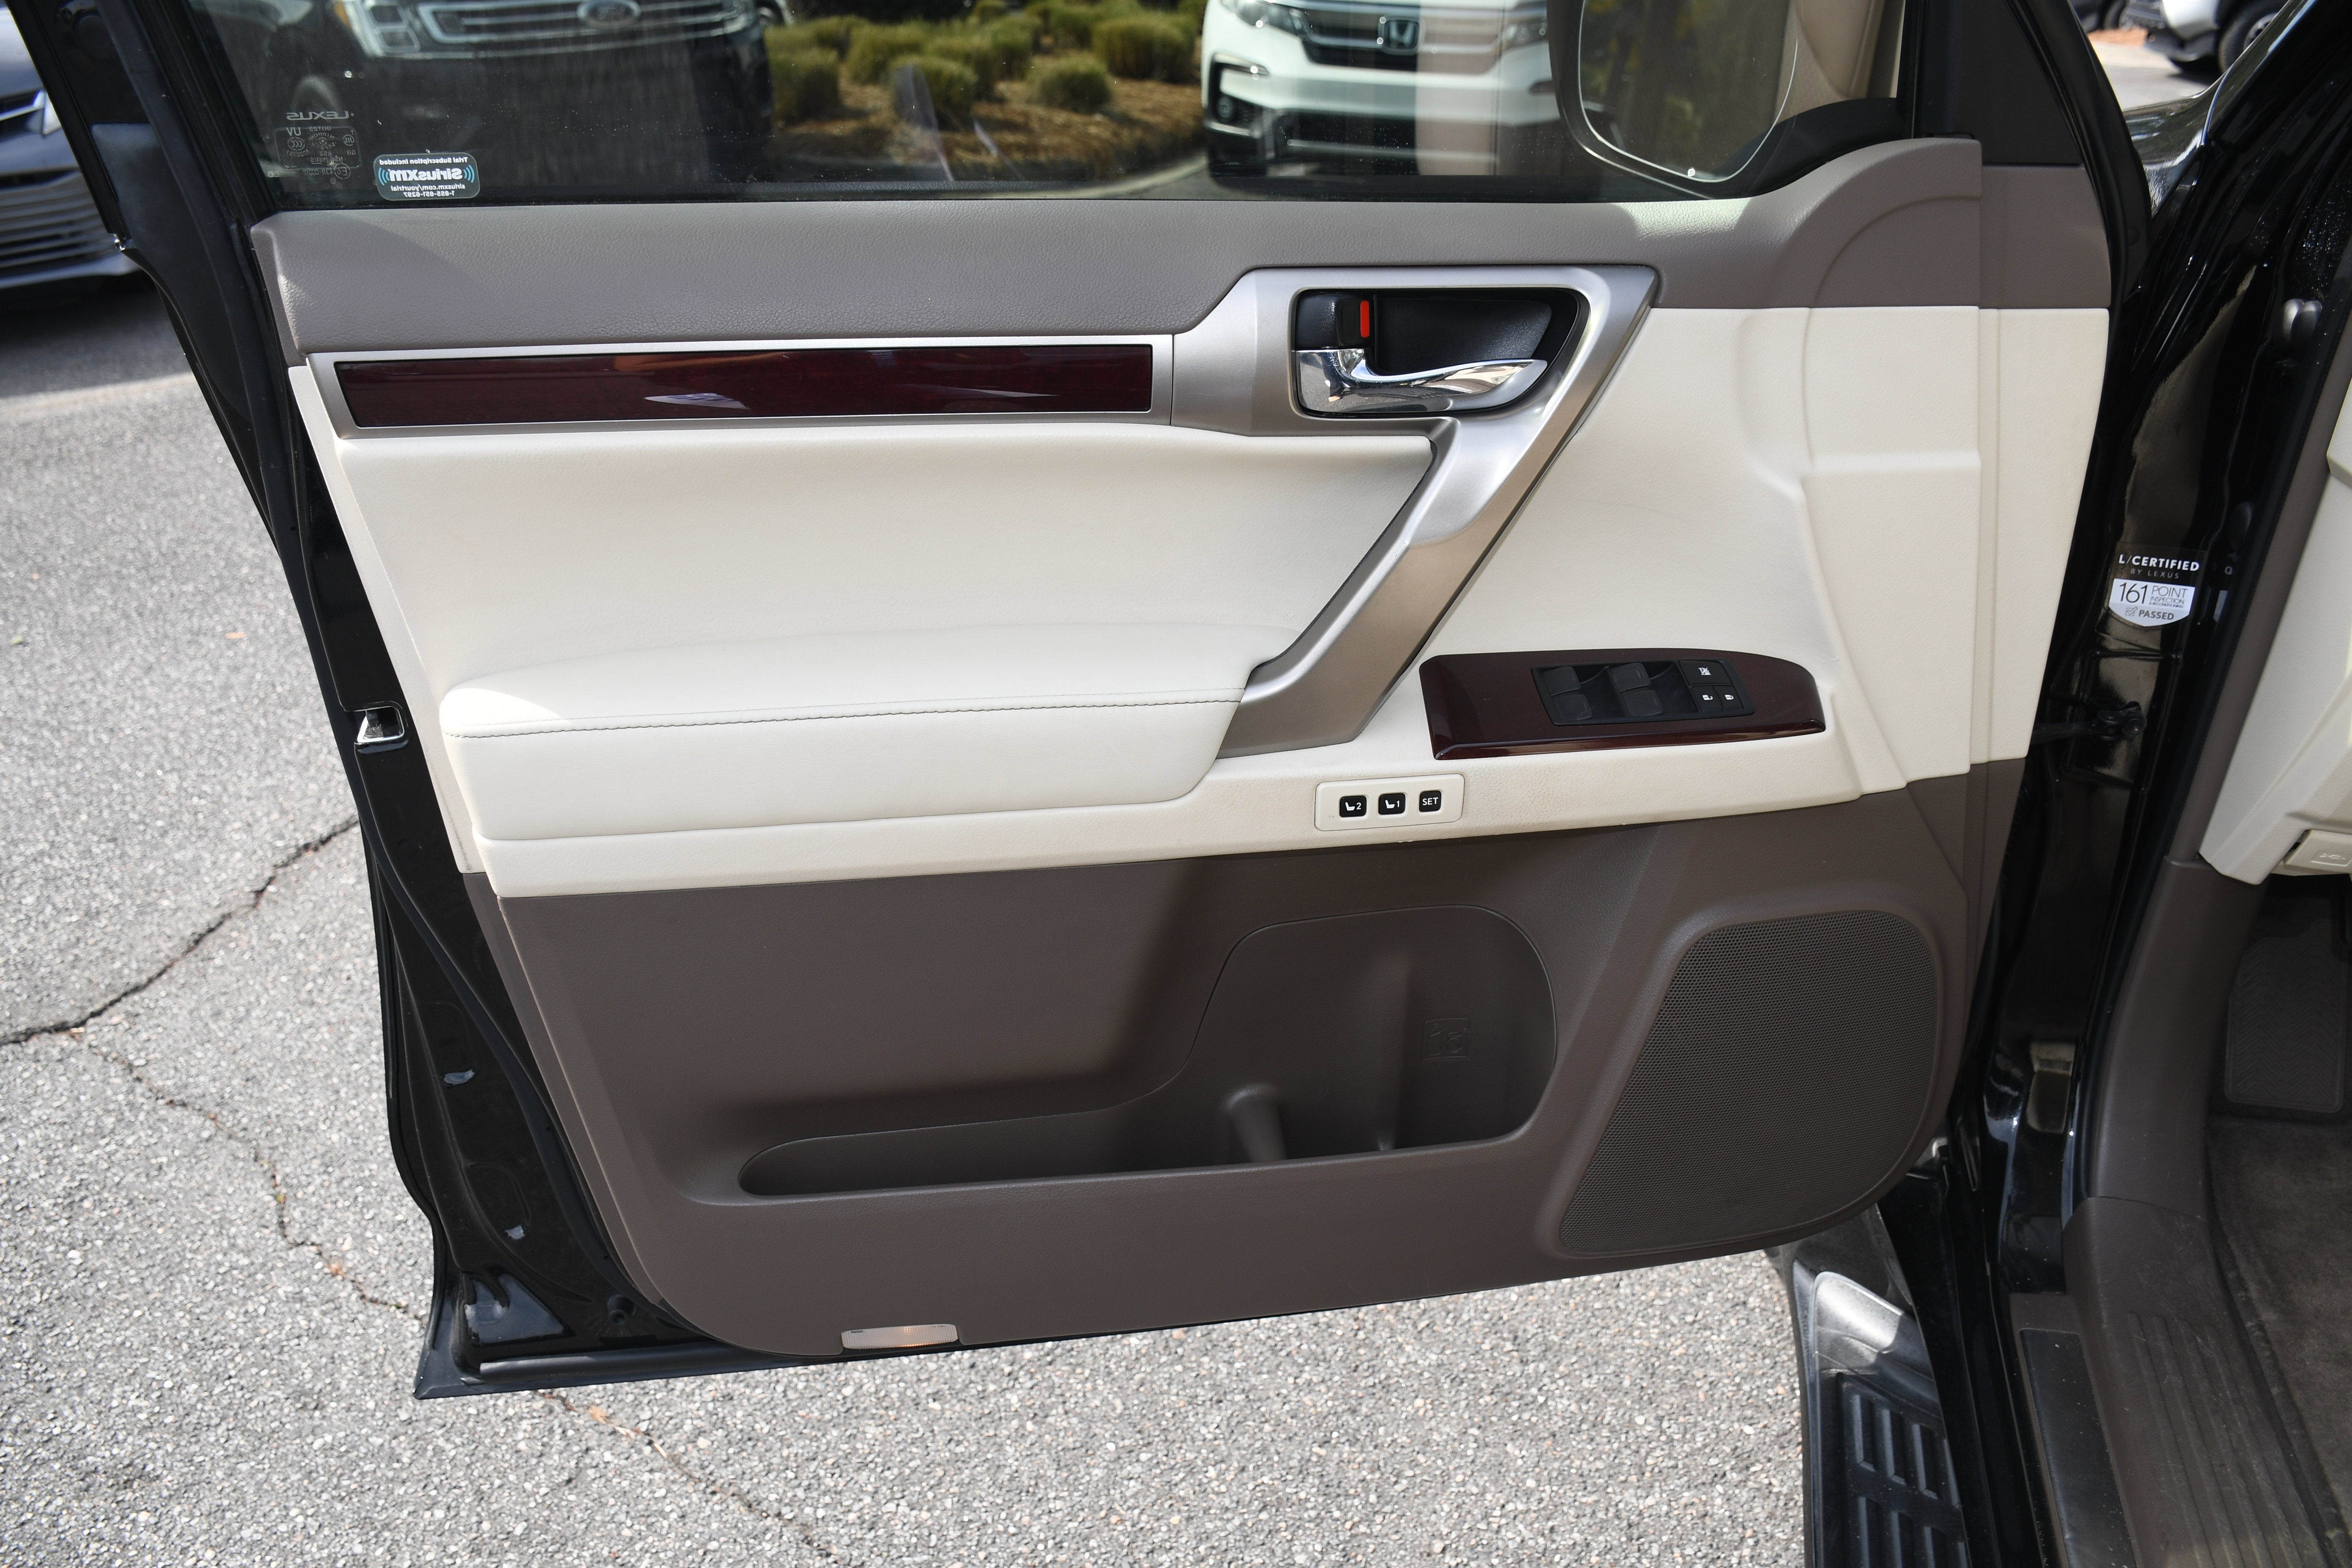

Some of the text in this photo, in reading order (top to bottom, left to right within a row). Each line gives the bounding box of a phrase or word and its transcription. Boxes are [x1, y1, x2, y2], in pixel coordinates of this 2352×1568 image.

[2148, 570, 2179, 579] LEXUS
[2119, 582, 2148, 604] 161
[2151, 585, 2188, 598] POINT
[2150, 596, 2185, 604] INSPECTION
[2139, 610, 2174, 620] PASSED
[1422, 797, 1439, 806] SET
